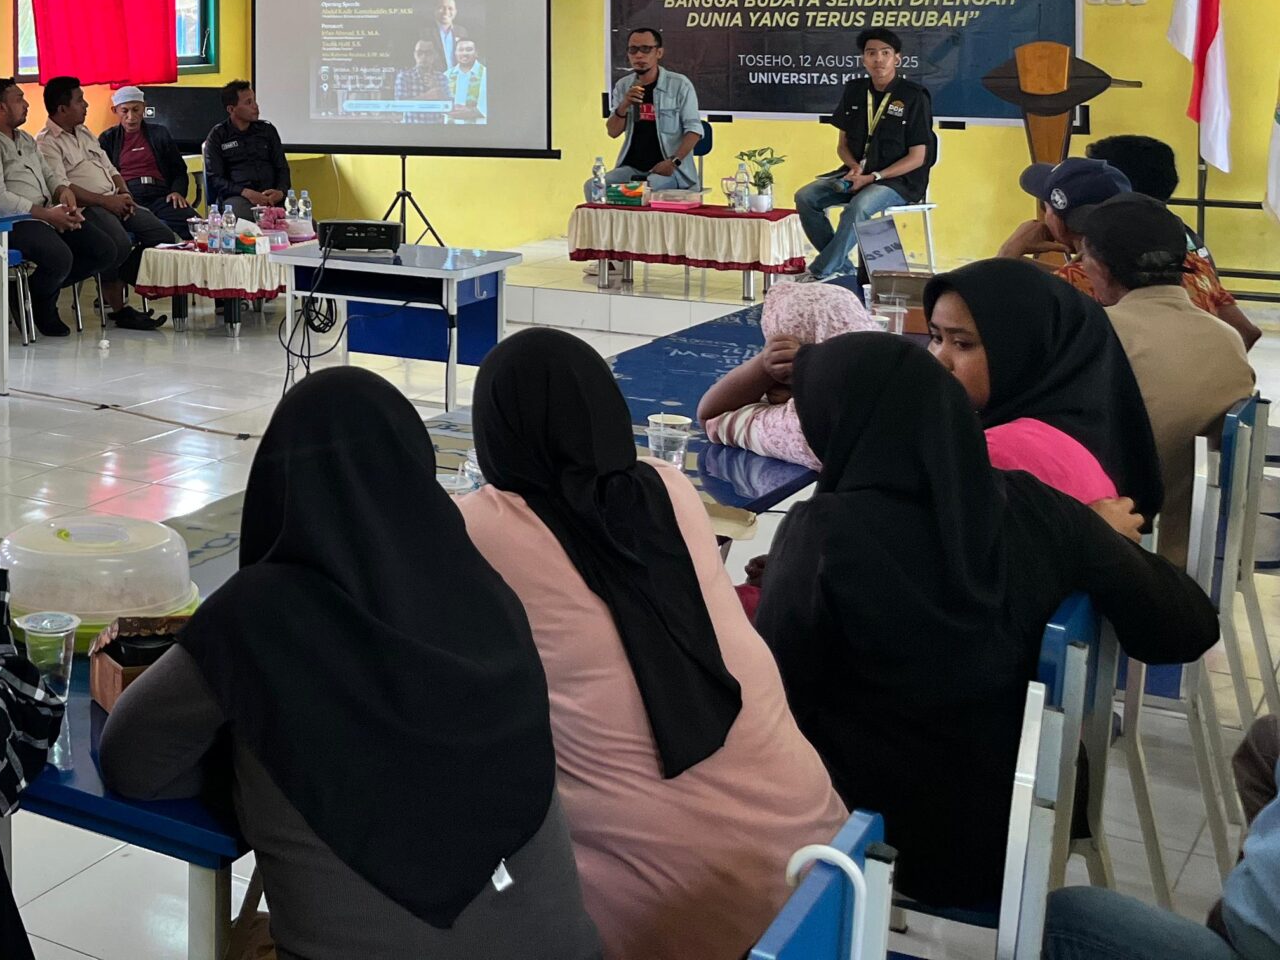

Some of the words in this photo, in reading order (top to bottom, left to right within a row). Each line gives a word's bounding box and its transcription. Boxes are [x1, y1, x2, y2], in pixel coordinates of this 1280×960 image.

[686, 11, 743, 28] DUNIA
[748, 11, 800, 27] YANG
[805, 11, 866, 27] TERUS
[871, 10, 980, 27] BERUBAH”
[738, 54, 796, 68] TOSEHO,
[798, 55, 812, 67] 12
[815, 55, 862, 68] AGUST
[748, 73, 838, 85] UNIVERSITAS
